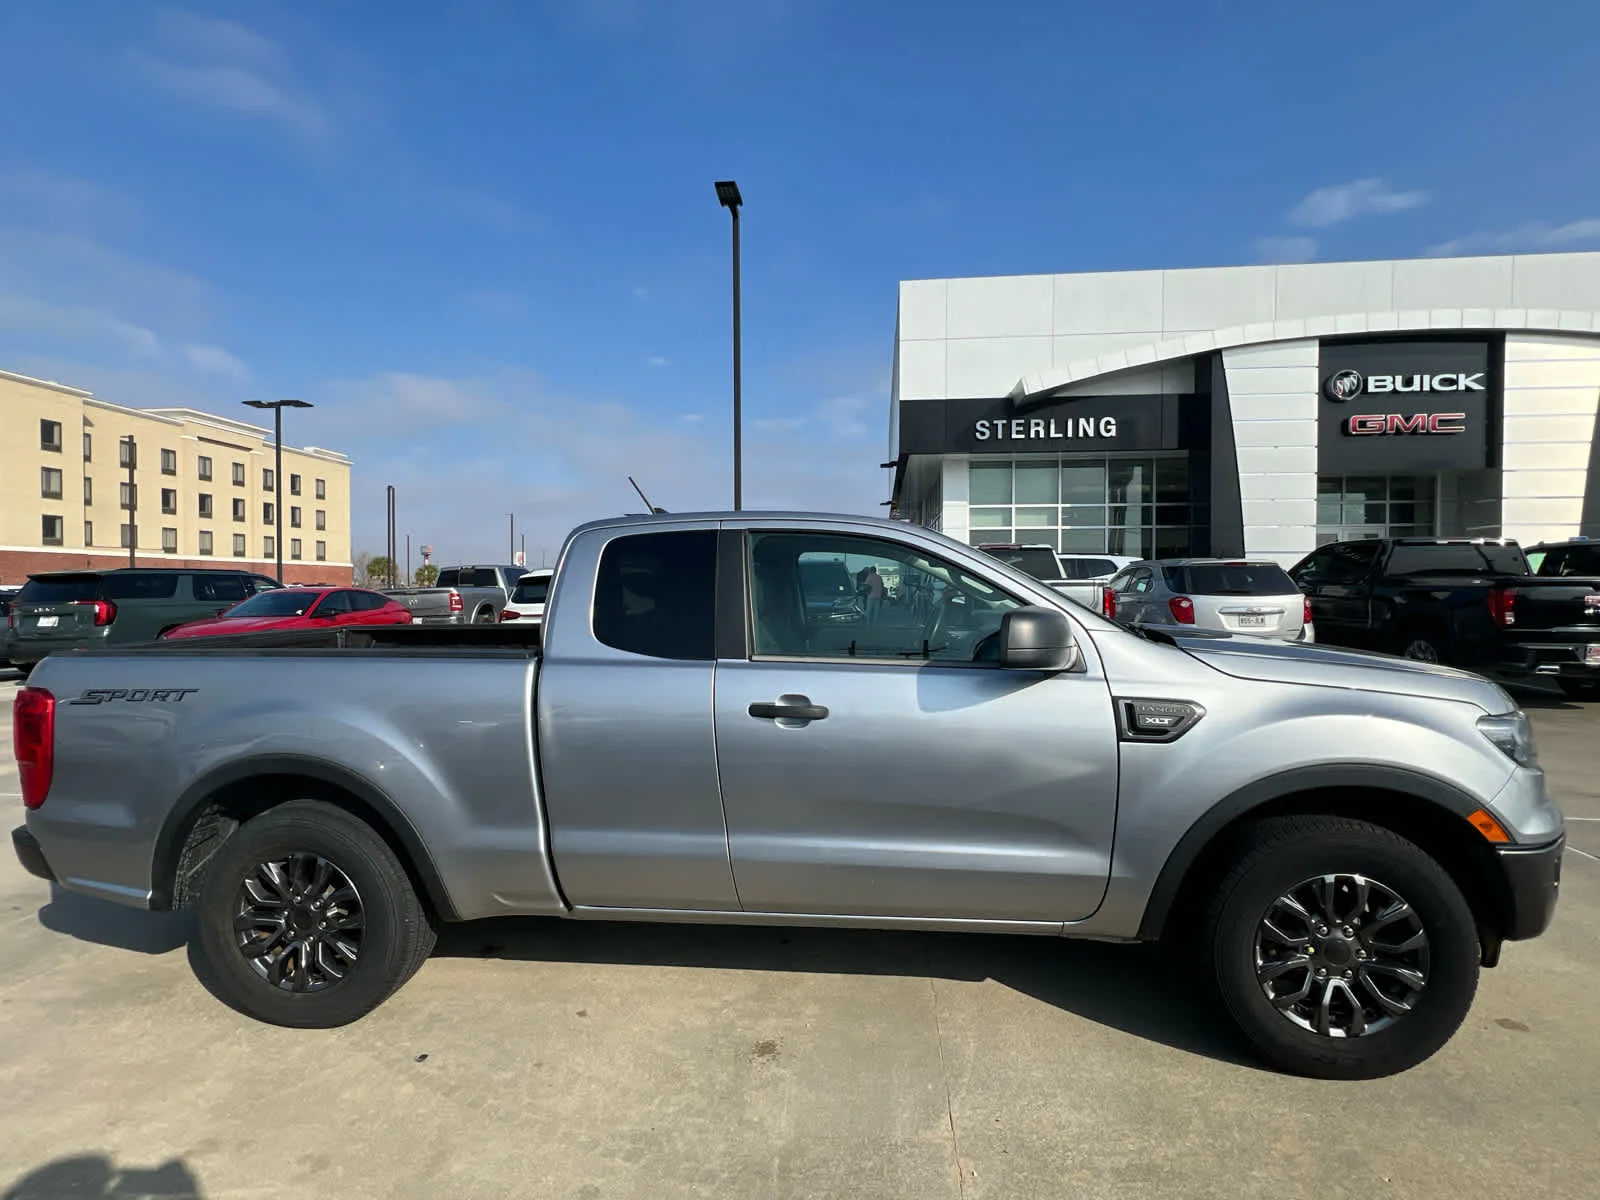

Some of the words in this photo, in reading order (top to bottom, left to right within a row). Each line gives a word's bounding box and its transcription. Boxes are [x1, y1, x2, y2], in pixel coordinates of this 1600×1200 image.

[1367, 373, 1486, 393] BUICK
[975, 416, 1117, 440] STERLING
[1350, 412, 1466, 435] GMC
[69, 688, 200, 705] SPORT
[1145, 717, 1173, 725] XLT
